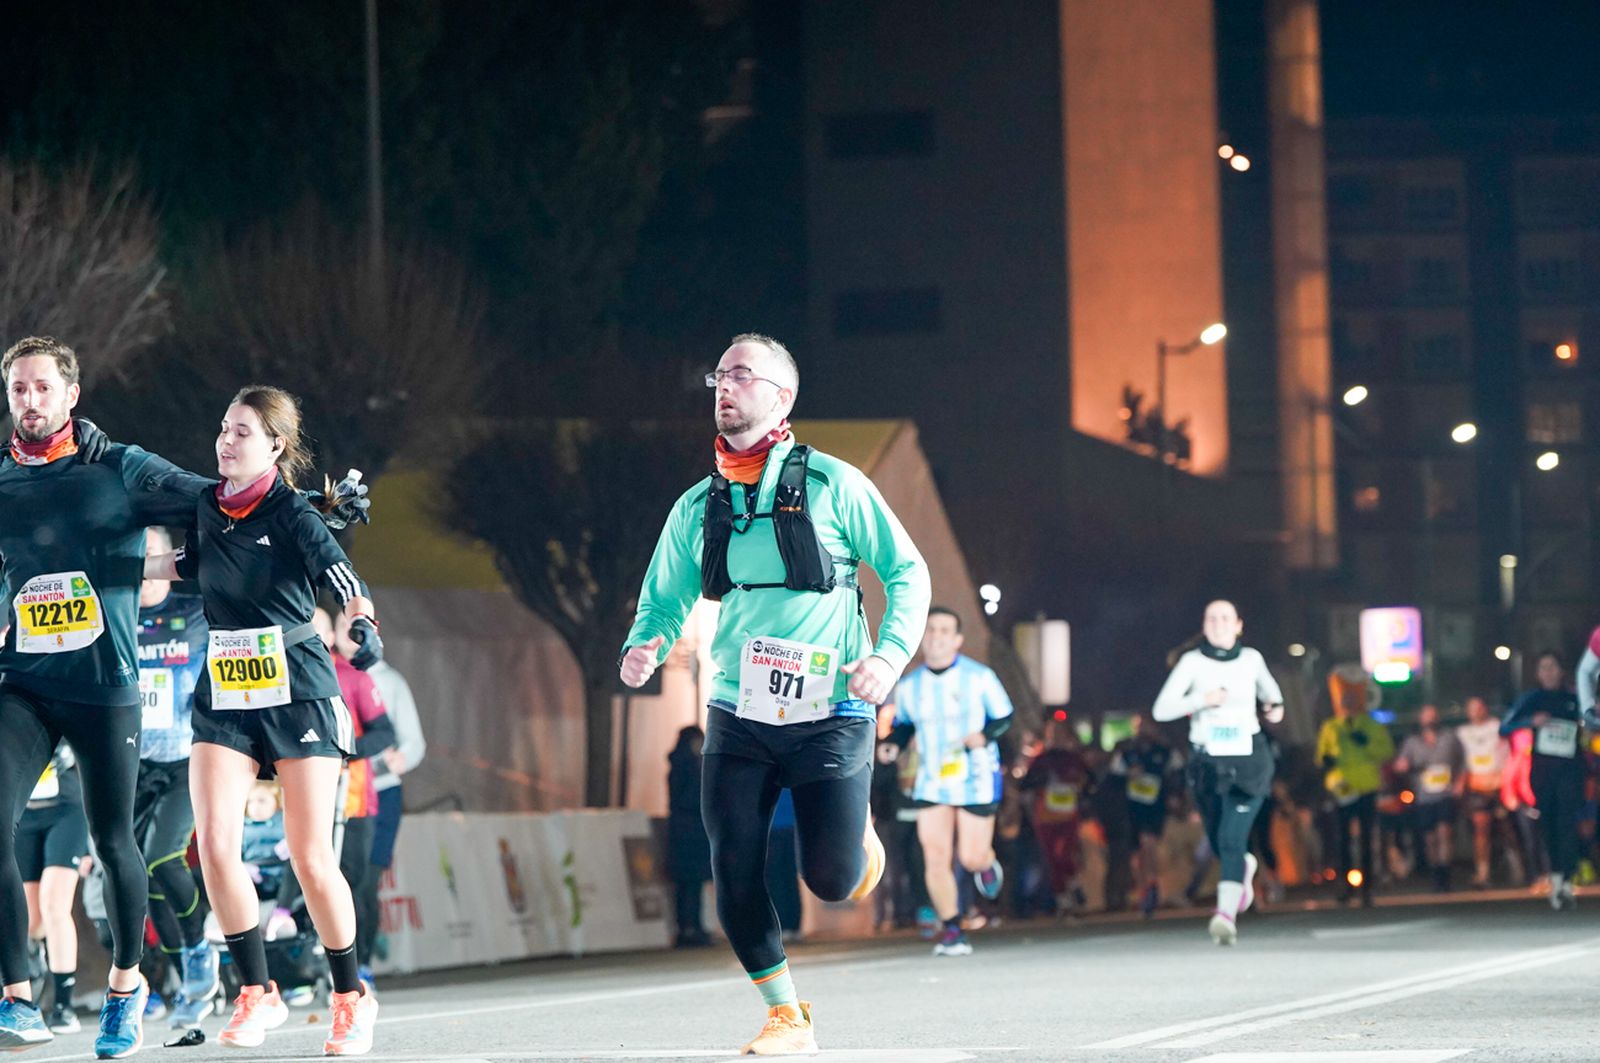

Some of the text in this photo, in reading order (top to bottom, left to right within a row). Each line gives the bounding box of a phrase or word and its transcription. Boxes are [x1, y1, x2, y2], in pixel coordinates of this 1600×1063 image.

[29, 584, 52, 593] NOCHE
[53, 581, 63, 591] DE
[21, 593, 37, 604] SAN
[28, 599, 88, 627] 12212
[138, 638, 190, 660] ANTÓN
[221, 637, 251, 648] NOCHE DE
[751, 655, 771, 666] SAN
[763, 646, 791, 659] NOCHE
[792, 651, 804, 661] DE
[215, 656, 277, 682] 12900
[768, 669, 805, 699] 971
